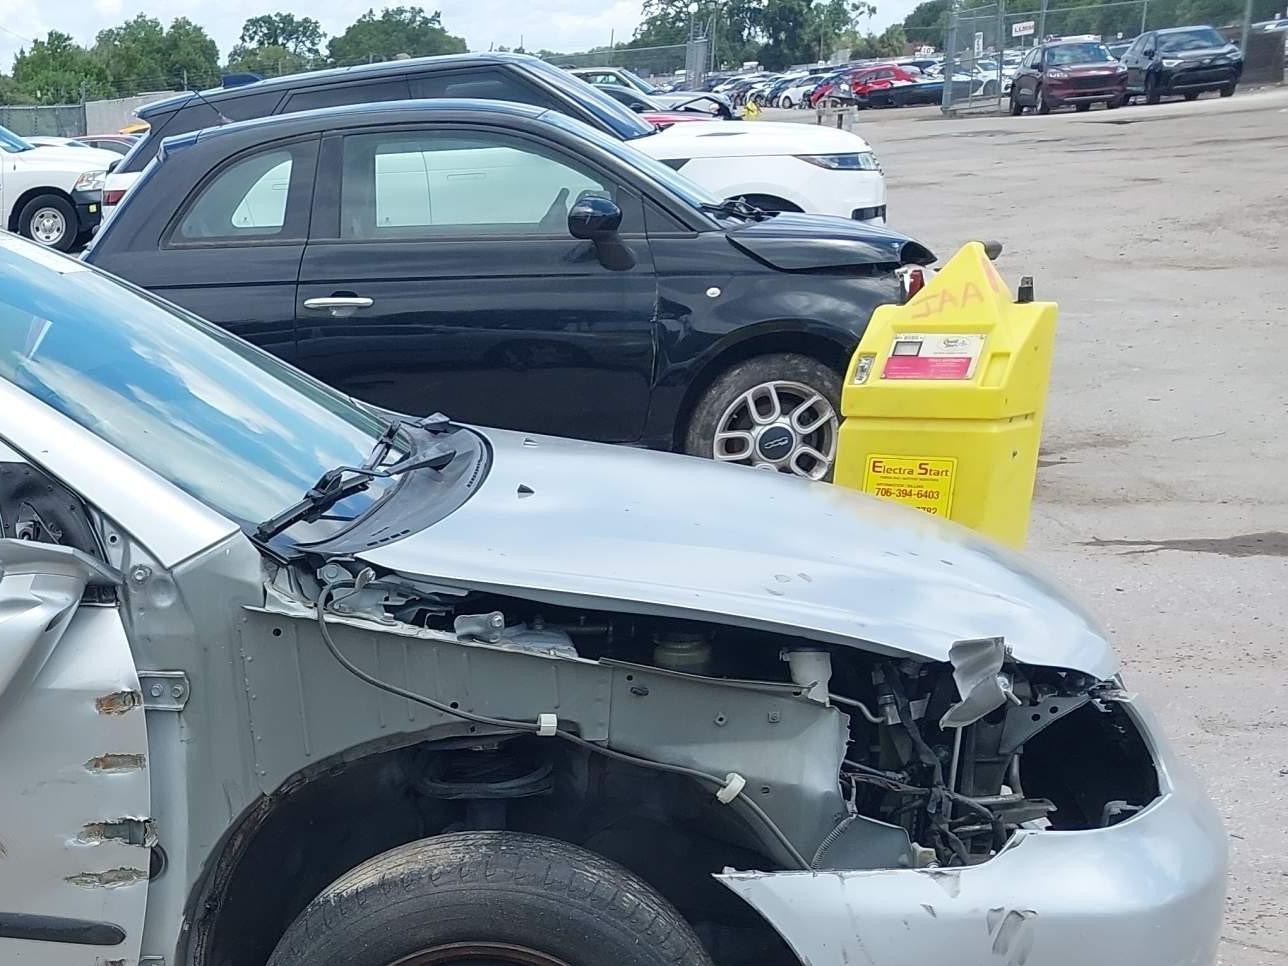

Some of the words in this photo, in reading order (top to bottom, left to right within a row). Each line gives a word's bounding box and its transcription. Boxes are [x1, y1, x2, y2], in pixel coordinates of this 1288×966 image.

[872, 460, 914, 475] Electra
[918, 463, 949, 476] Start
[875, 487, 940, 499] 706-394-6403
